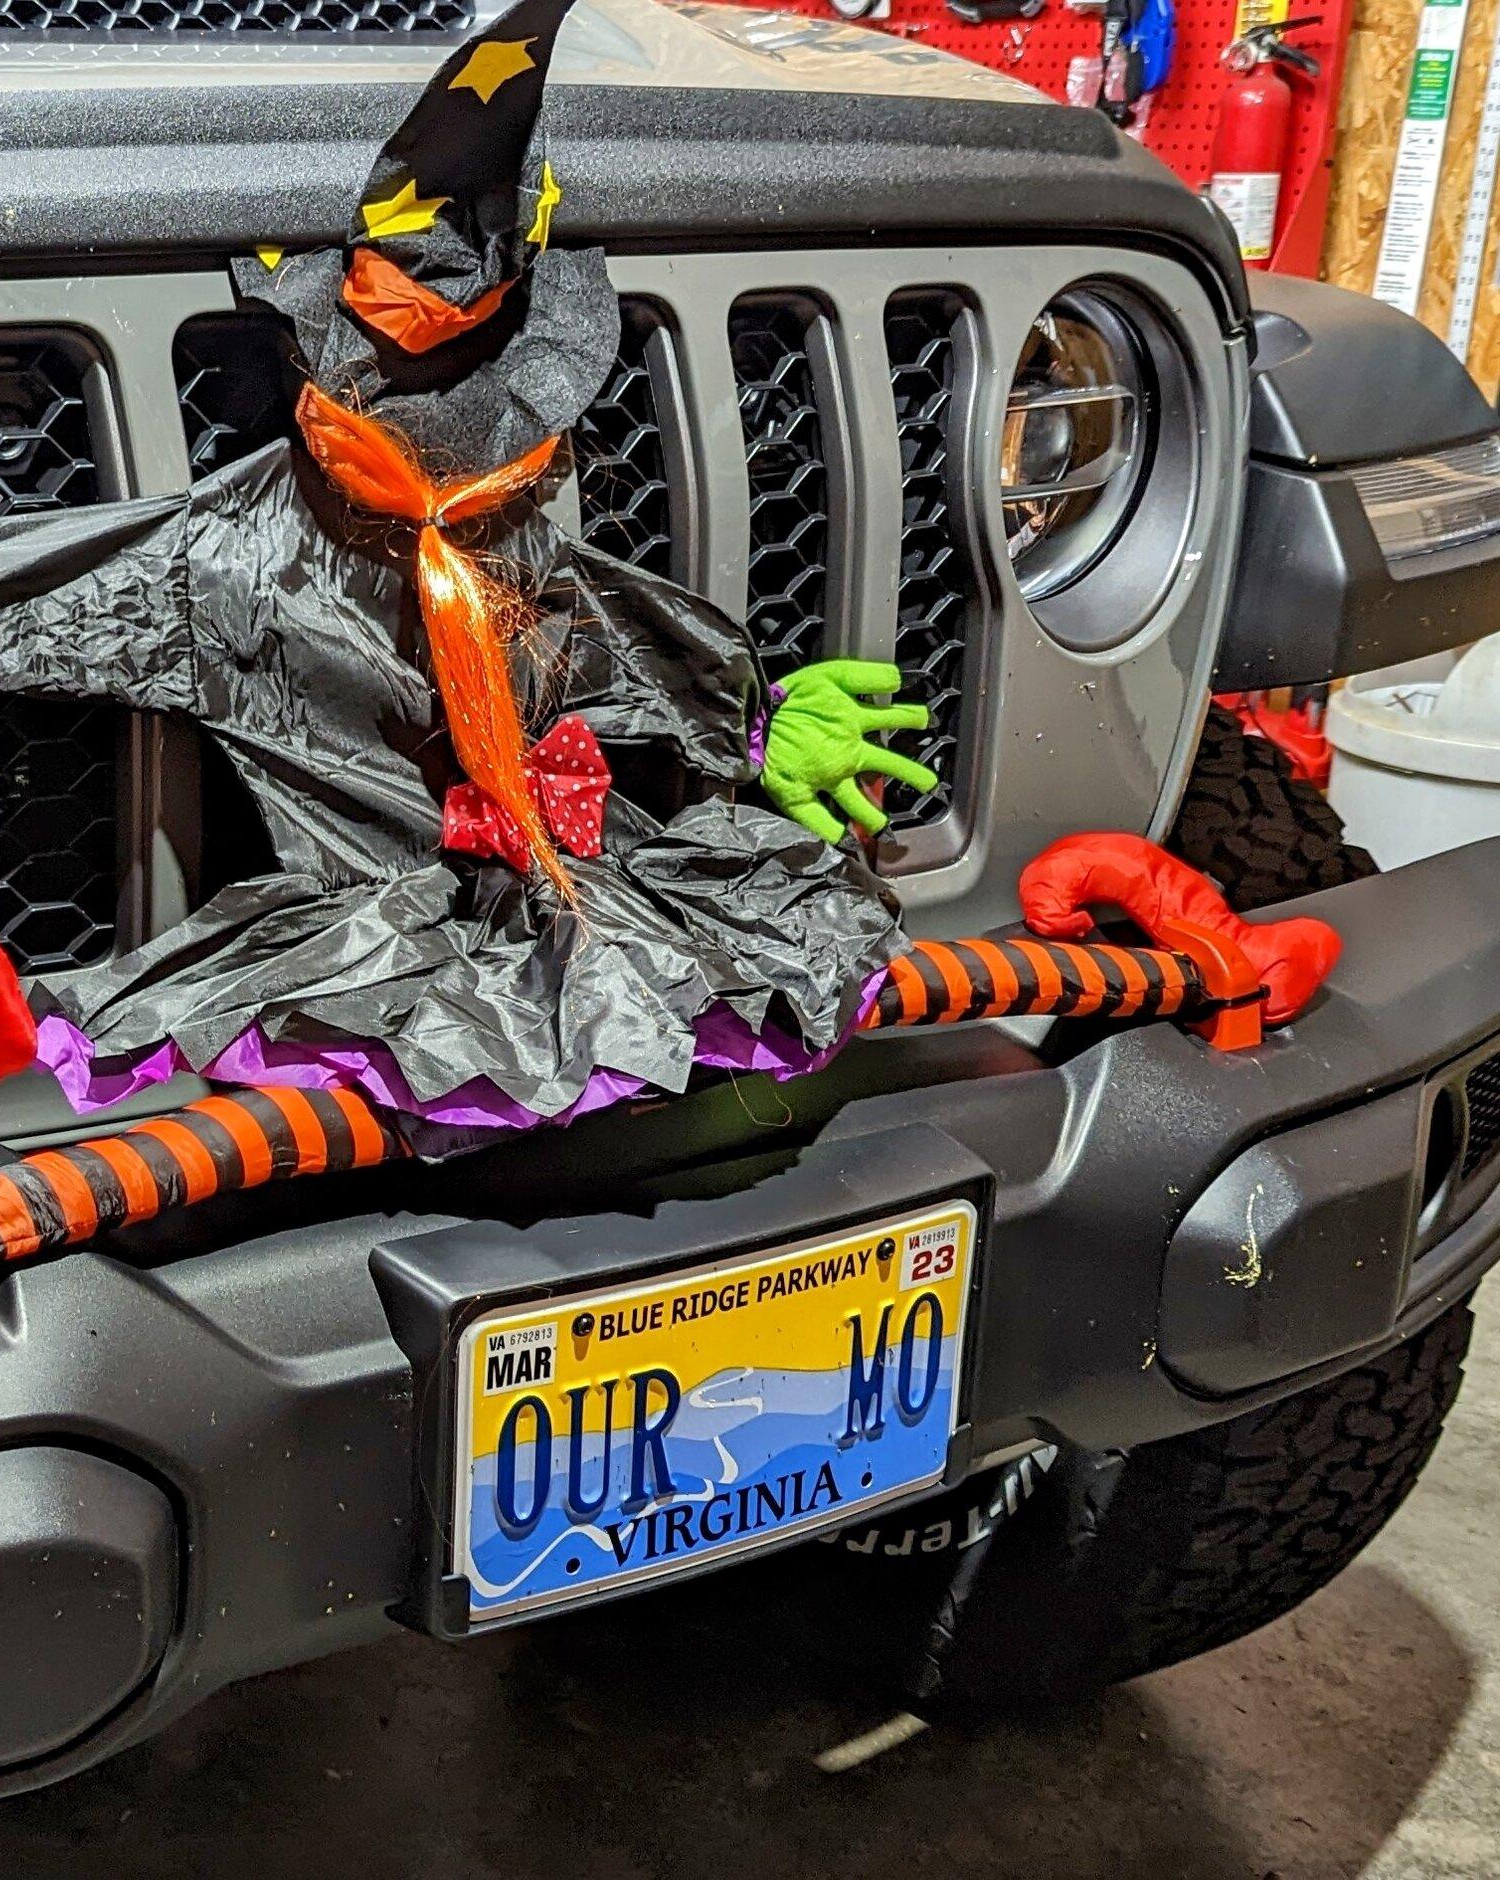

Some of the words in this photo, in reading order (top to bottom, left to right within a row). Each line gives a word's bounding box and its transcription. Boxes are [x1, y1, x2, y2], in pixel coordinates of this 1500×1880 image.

[909, 1235, 920, 1250] VA
[911, 1244, 955, 1281] 23
[599, 1302, 664, 1341] BLUE
[671, 1281, 750, 1324] RIDGE
[757, 1248, 873, 1302] PARKWAY
[489, 1335, 505, 1351] VA
[510, 1327, 552, 1345] 6792813
[487, 1346, 552, 1390] MAR
[496, 1367, 681, 1529] OUR
[841, 1292, 944, 1441] MO
[604, 1460, 843, 1567] VIRGINIA
